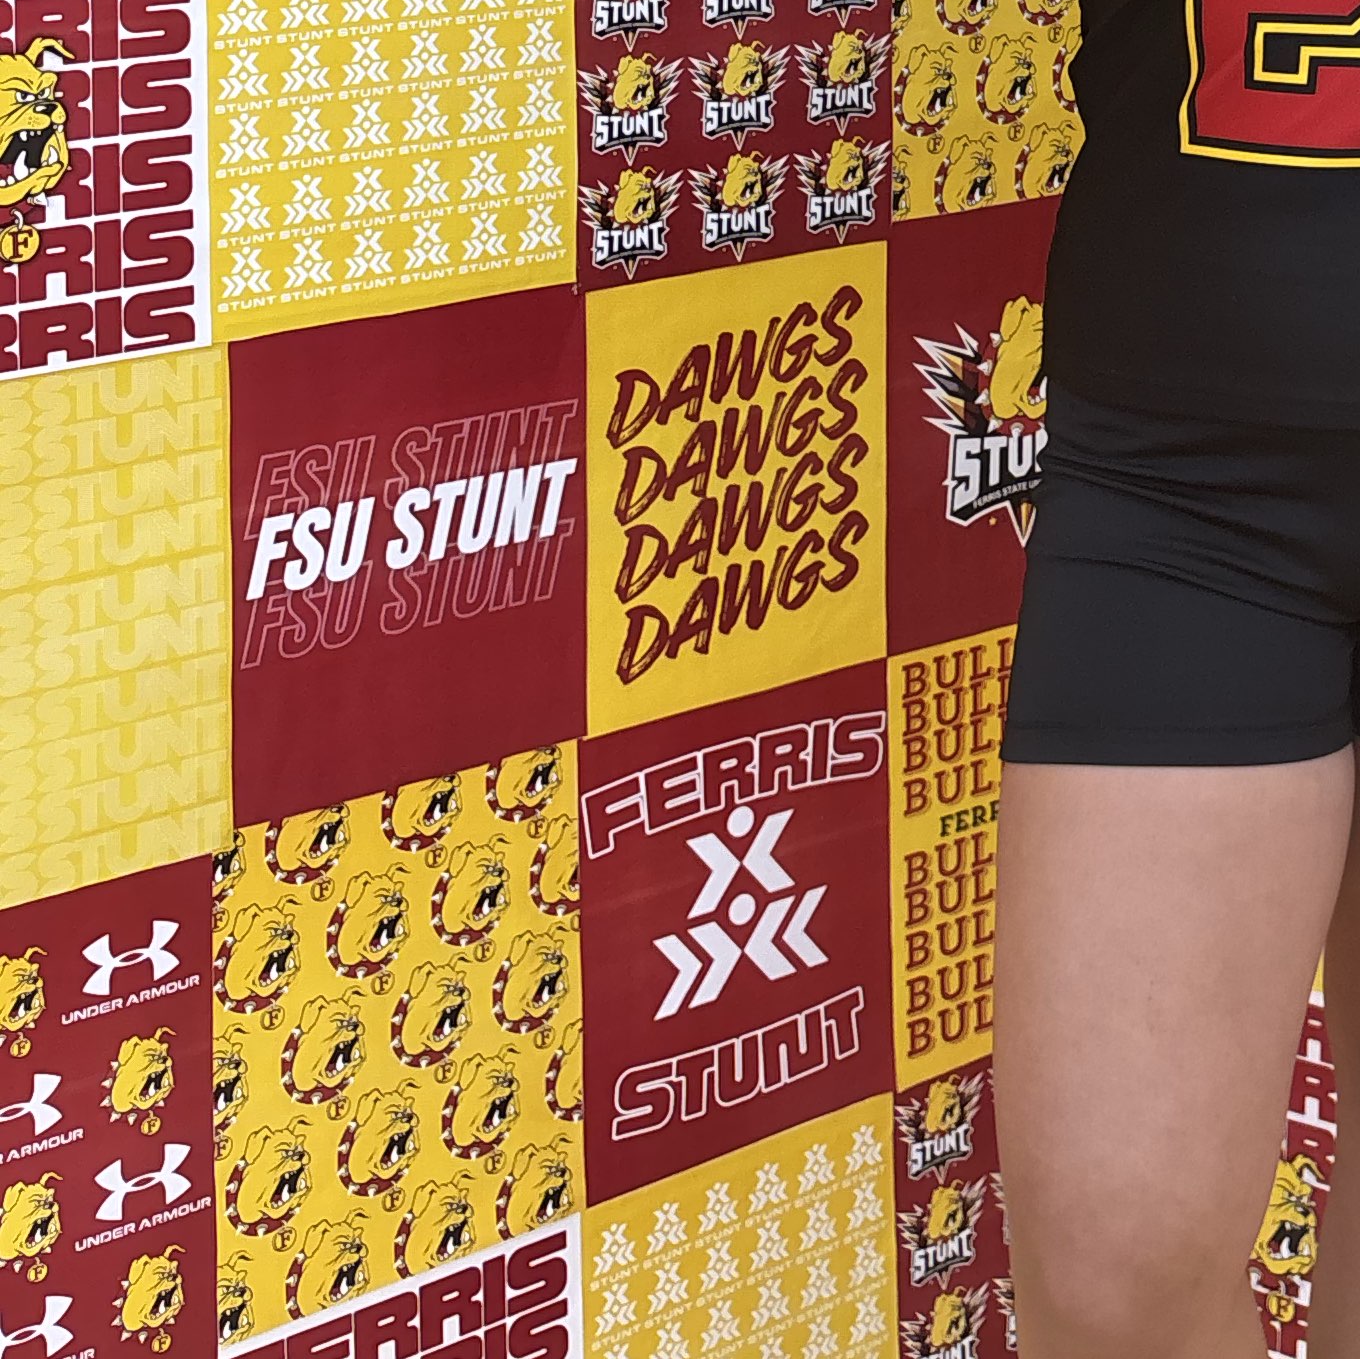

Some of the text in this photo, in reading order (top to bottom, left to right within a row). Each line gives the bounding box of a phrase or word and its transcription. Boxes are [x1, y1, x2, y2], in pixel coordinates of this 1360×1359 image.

[8, 231, 32, 261] F
[594, 223, 665, 258] STUNT
[705, 205, 771, 239] STUNT
[809, 191, 873, 221] STUNT
[607, 285, 862, 450] DAWGS
[243, 399, 579, 541] FSU STUNT
[612, 358, 866, 526] DAWGS
[953, 433, 1048, 511] STU
[246, 458, 578, 601] FSU STUNT
[614, 433, 869, 604] DAWGS
[241, 518, 575, 670] FSU STUNT
[615, 510, 869, 685] DAWGS
[581, 711, 885, 859] FERRIS
[61, 975, 200, 1026] UNDER ARMOUR
[611, 986, 863, 1140] STUNT
[6, 1128, 84, 1162] ARMOUR
[74, 1196, 212, 1252] UNDER ARMOUR
